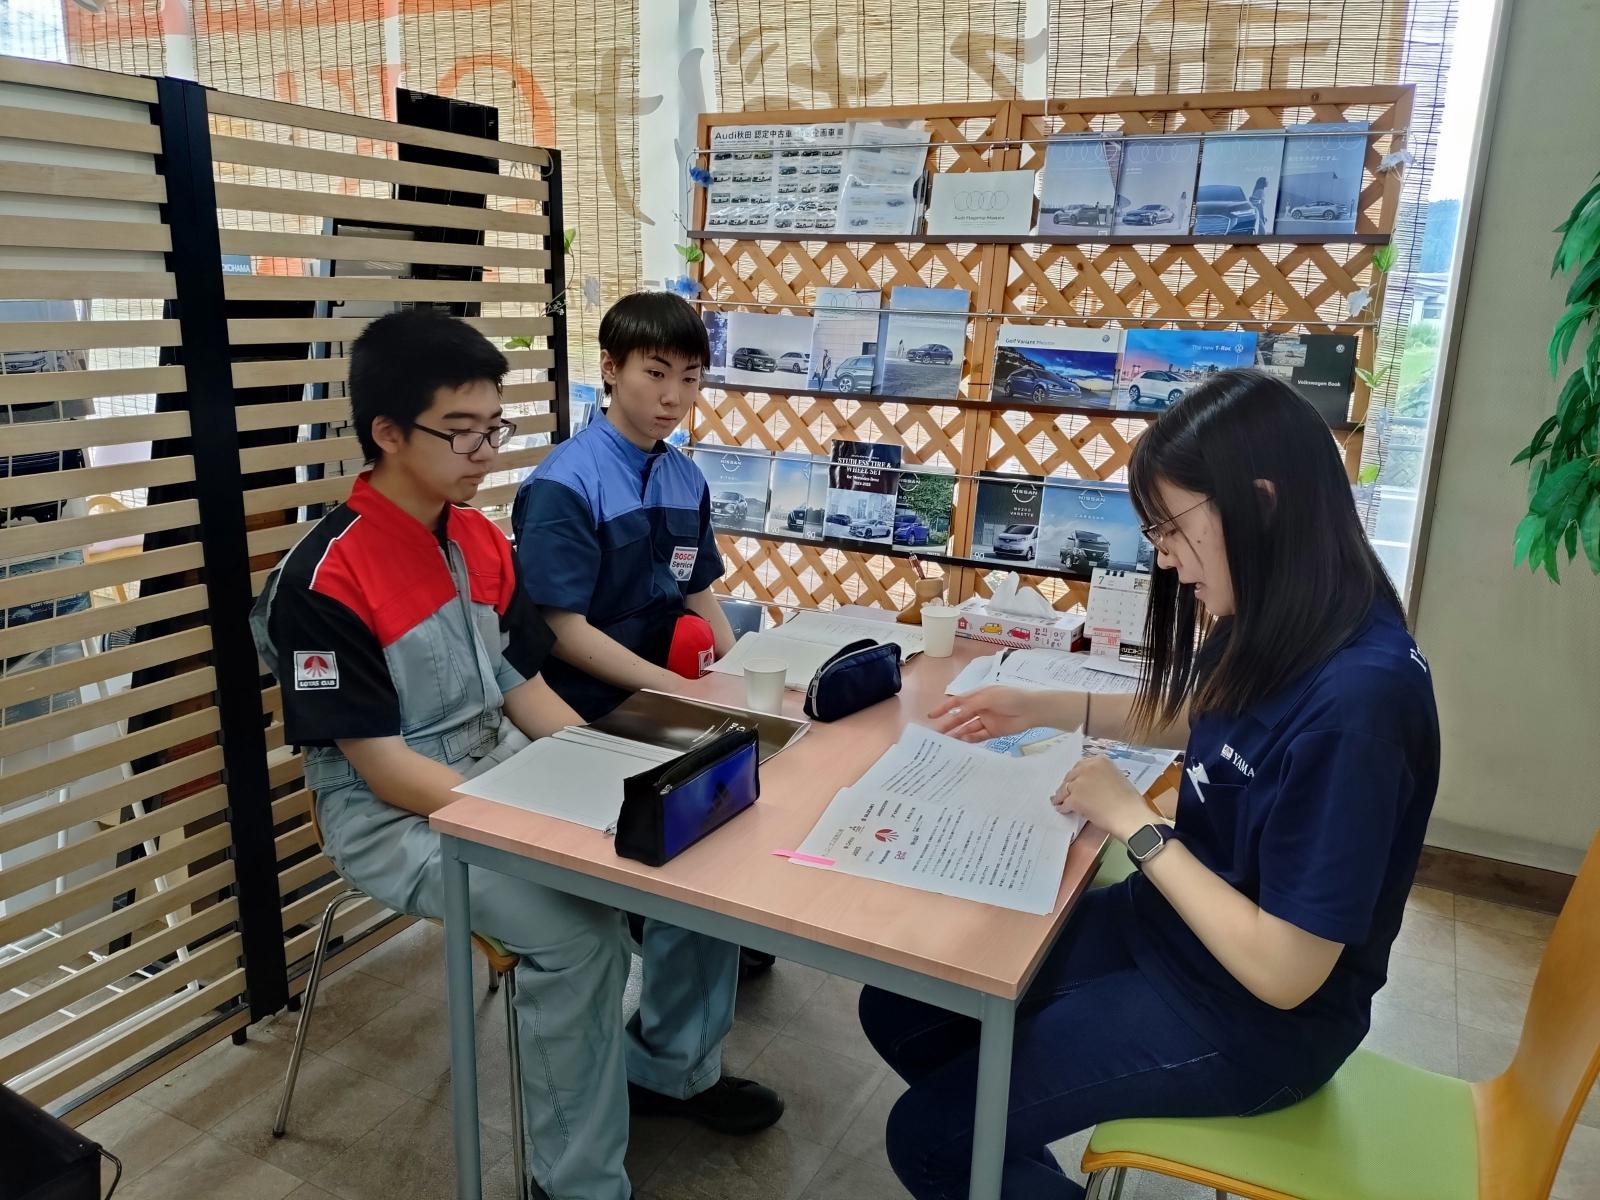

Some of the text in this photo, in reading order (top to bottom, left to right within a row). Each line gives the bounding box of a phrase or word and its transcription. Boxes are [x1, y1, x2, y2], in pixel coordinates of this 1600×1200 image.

[754, 129, 792, 139] 認定中古車
[1011, 488, 1038, 496] NISSAN
[1078, 495, 1106, 503] NISSAN
[674, 552, 695, 561] BOSCH
[672, 561, 693, 569] Service
